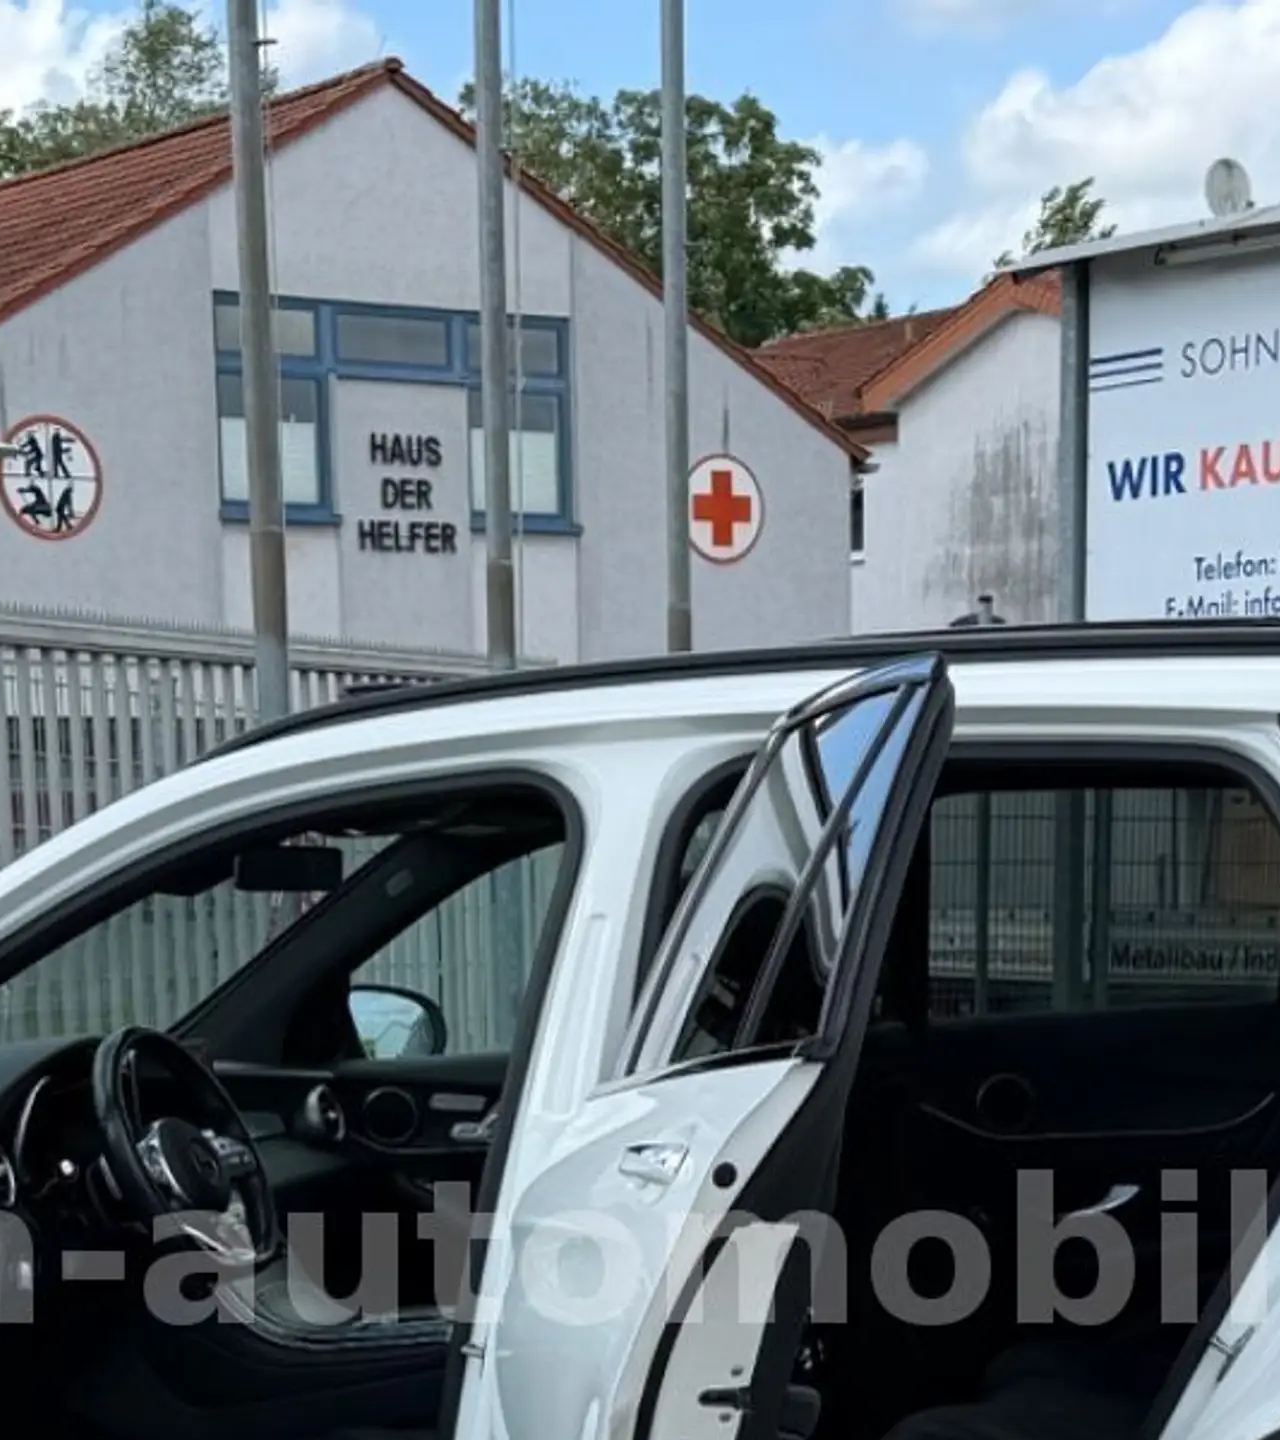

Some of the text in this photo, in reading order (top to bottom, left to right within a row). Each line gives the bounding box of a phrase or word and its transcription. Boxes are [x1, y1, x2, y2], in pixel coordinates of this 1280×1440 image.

[369, 431, 443, 468] HAUS
[380, 476, 433, 511] DER
[1106, 451, 1187, 502] WIR
[356, 518, 458, 556] HELFER
[1193, 550, 1276, 582] Telefon:
